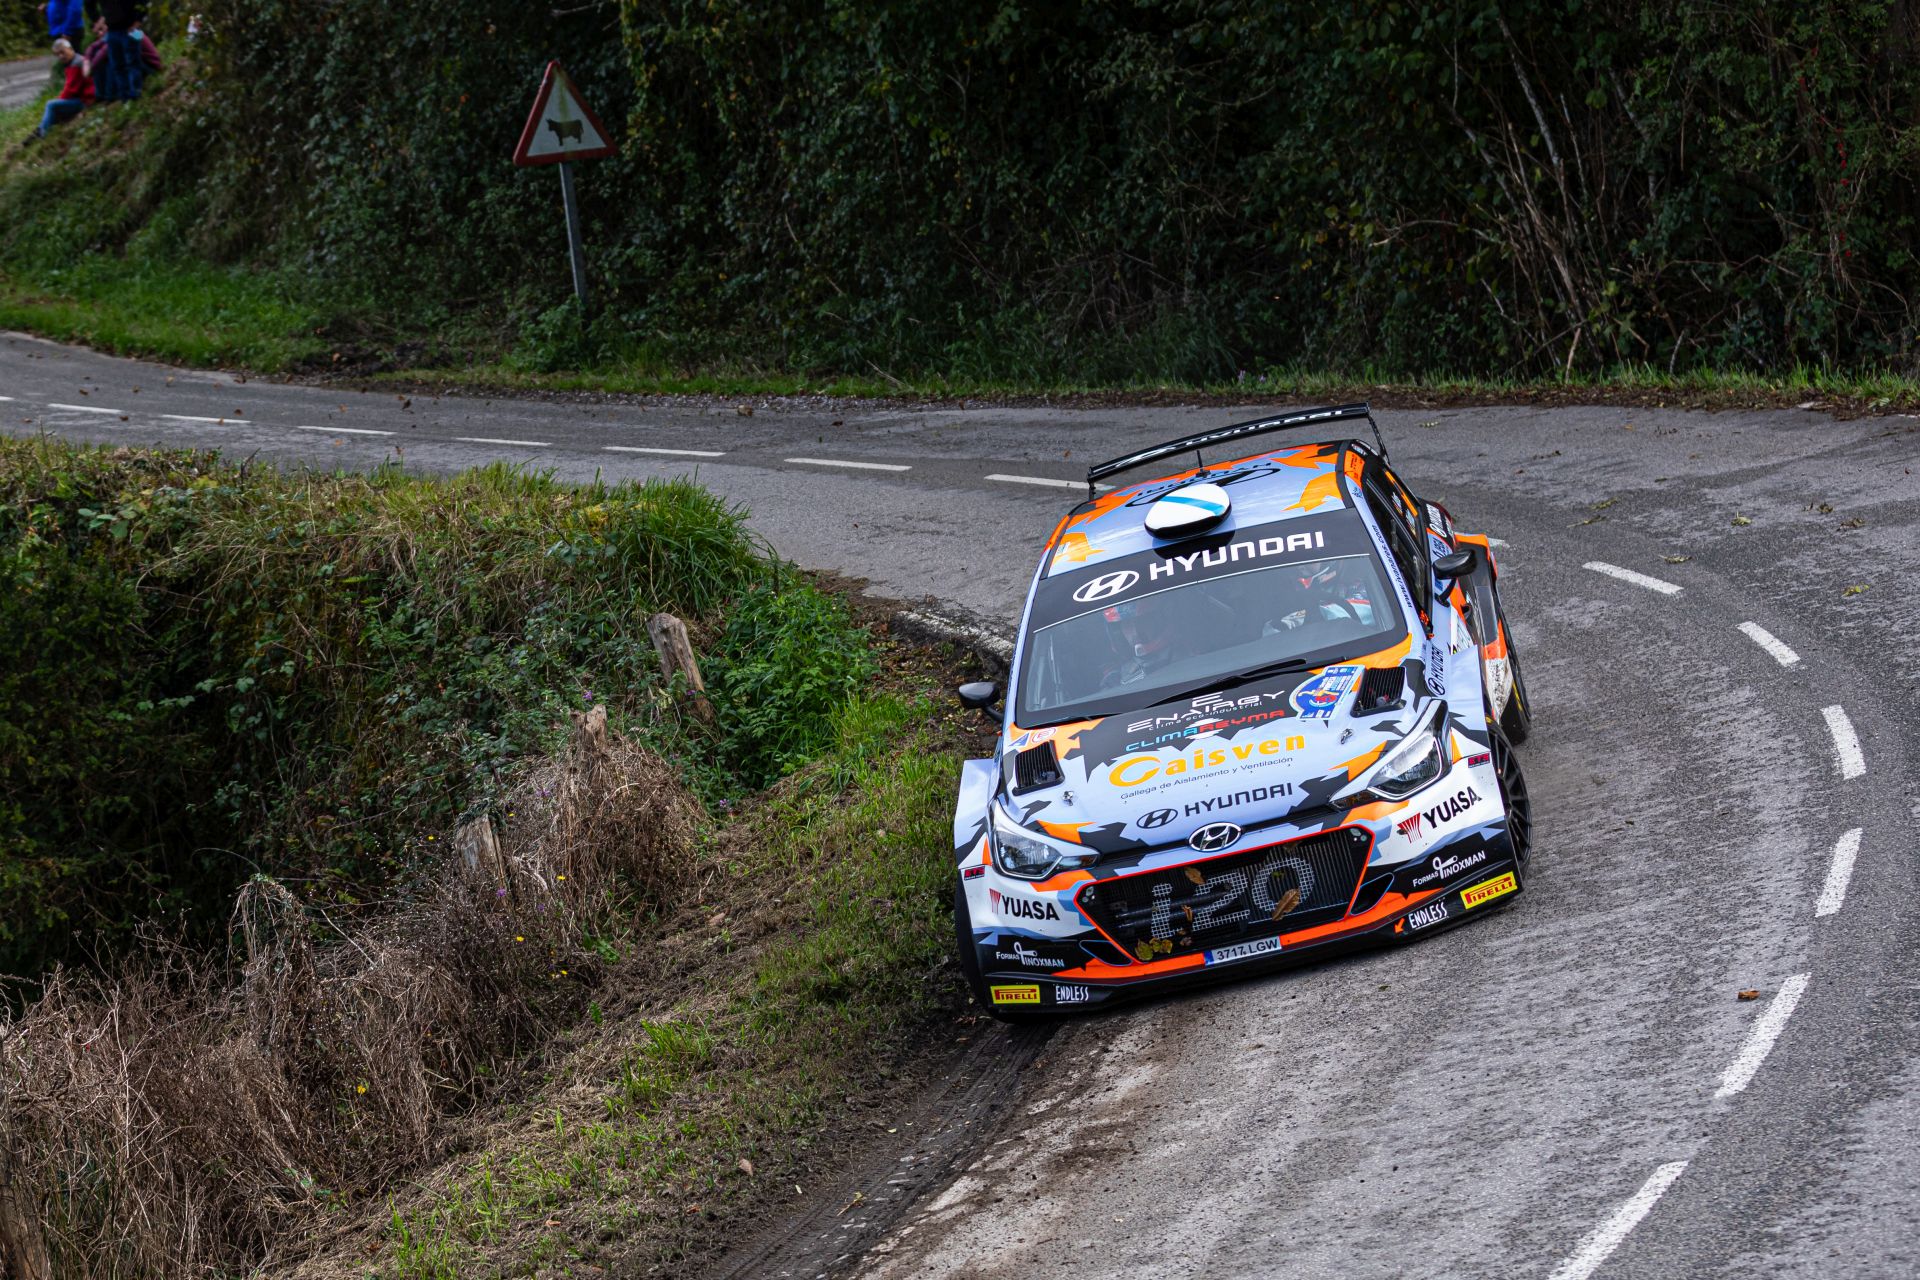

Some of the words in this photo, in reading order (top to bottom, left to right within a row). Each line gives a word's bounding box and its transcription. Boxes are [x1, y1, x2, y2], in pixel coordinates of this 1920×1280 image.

[1150, 531, 1325, 581] HYUNDAI
[1125, 709, 1285, 752] CLIMAREYMA
[1149, 717, 1182, 731] clima
[1186, 702, 1263, 721] eco-industrial
[1108, 735, 1305, 788] Caisven
[1120, 785, 1157, 800] Gallega
[1159, 781, 1172, 790] de
[1174, 769, 1230, 786] Aislamiento
[1240, 757, 1293, 771] Ventilación
[1184, 782, 1293, 817] HYUNDAI
[1423, 786, 1483, 829] YUASA
[1443, 851, 1486, 880] INOXMAN
[1151, 857, 1316, 940] i20
[1464, 876, 1513, 905] PIRELLI
[1001, 895, 1061, 921] YUASA
[1408, 901, 1448, 929] ENDLESS
[1024, 956, 1065, 968] INOXMAN
[1217, 946, 1246, 961] 3717
[1248, 938, 1278, 954] LGW
[994, 988, 1038, 1001] PIRELLI
[1055, 985, 1089, 1002] ENDLESS
